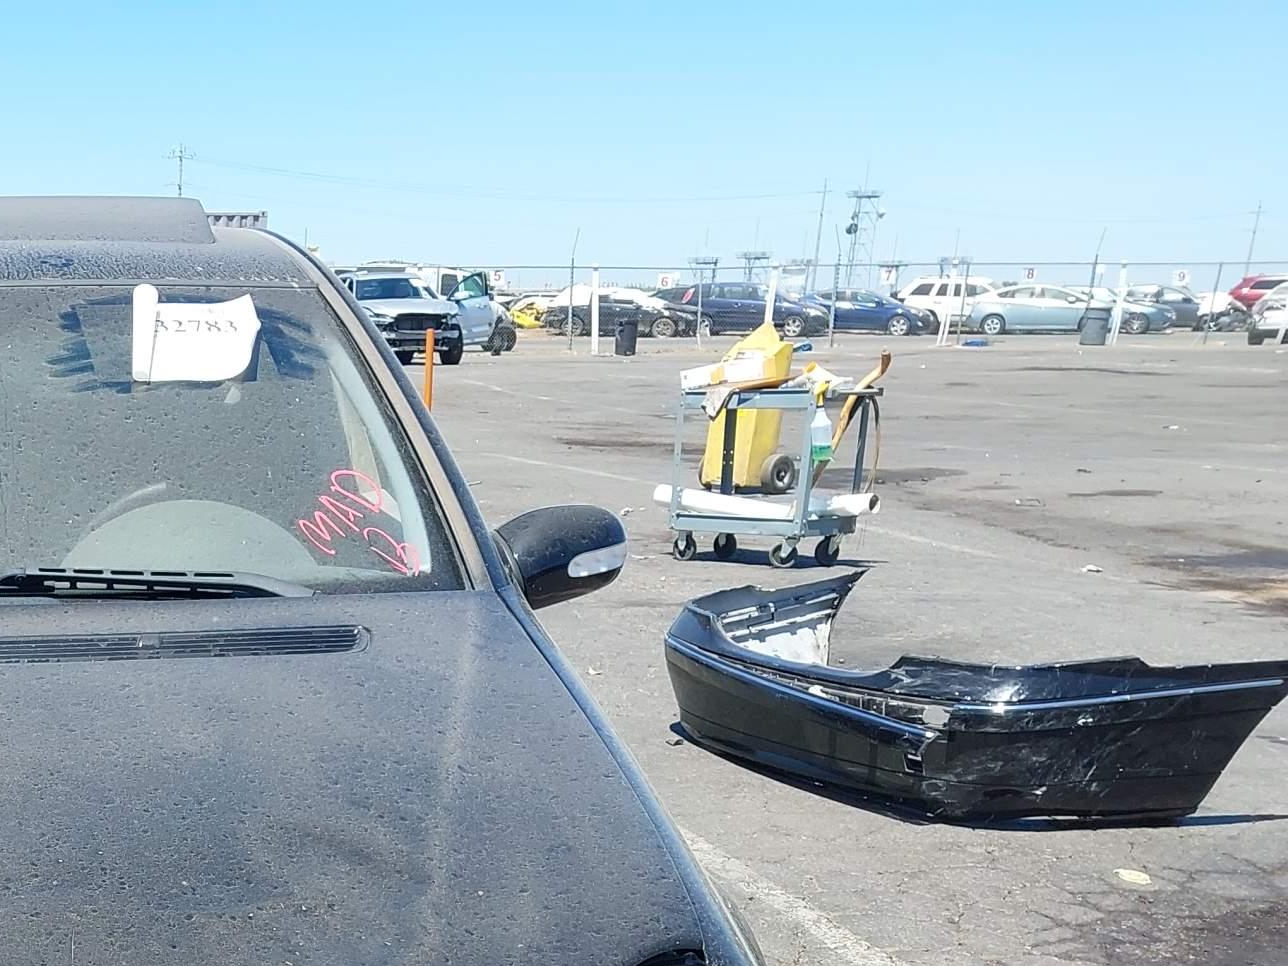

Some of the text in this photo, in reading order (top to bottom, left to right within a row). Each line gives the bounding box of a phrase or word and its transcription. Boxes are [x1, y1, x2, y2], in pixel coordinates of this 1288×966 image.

[493, 270, 501, 281] 5
[885, 270, 892, 281] 7
[661, 276, 669, 287] 6
[298, 469, 384, 555] MAD
